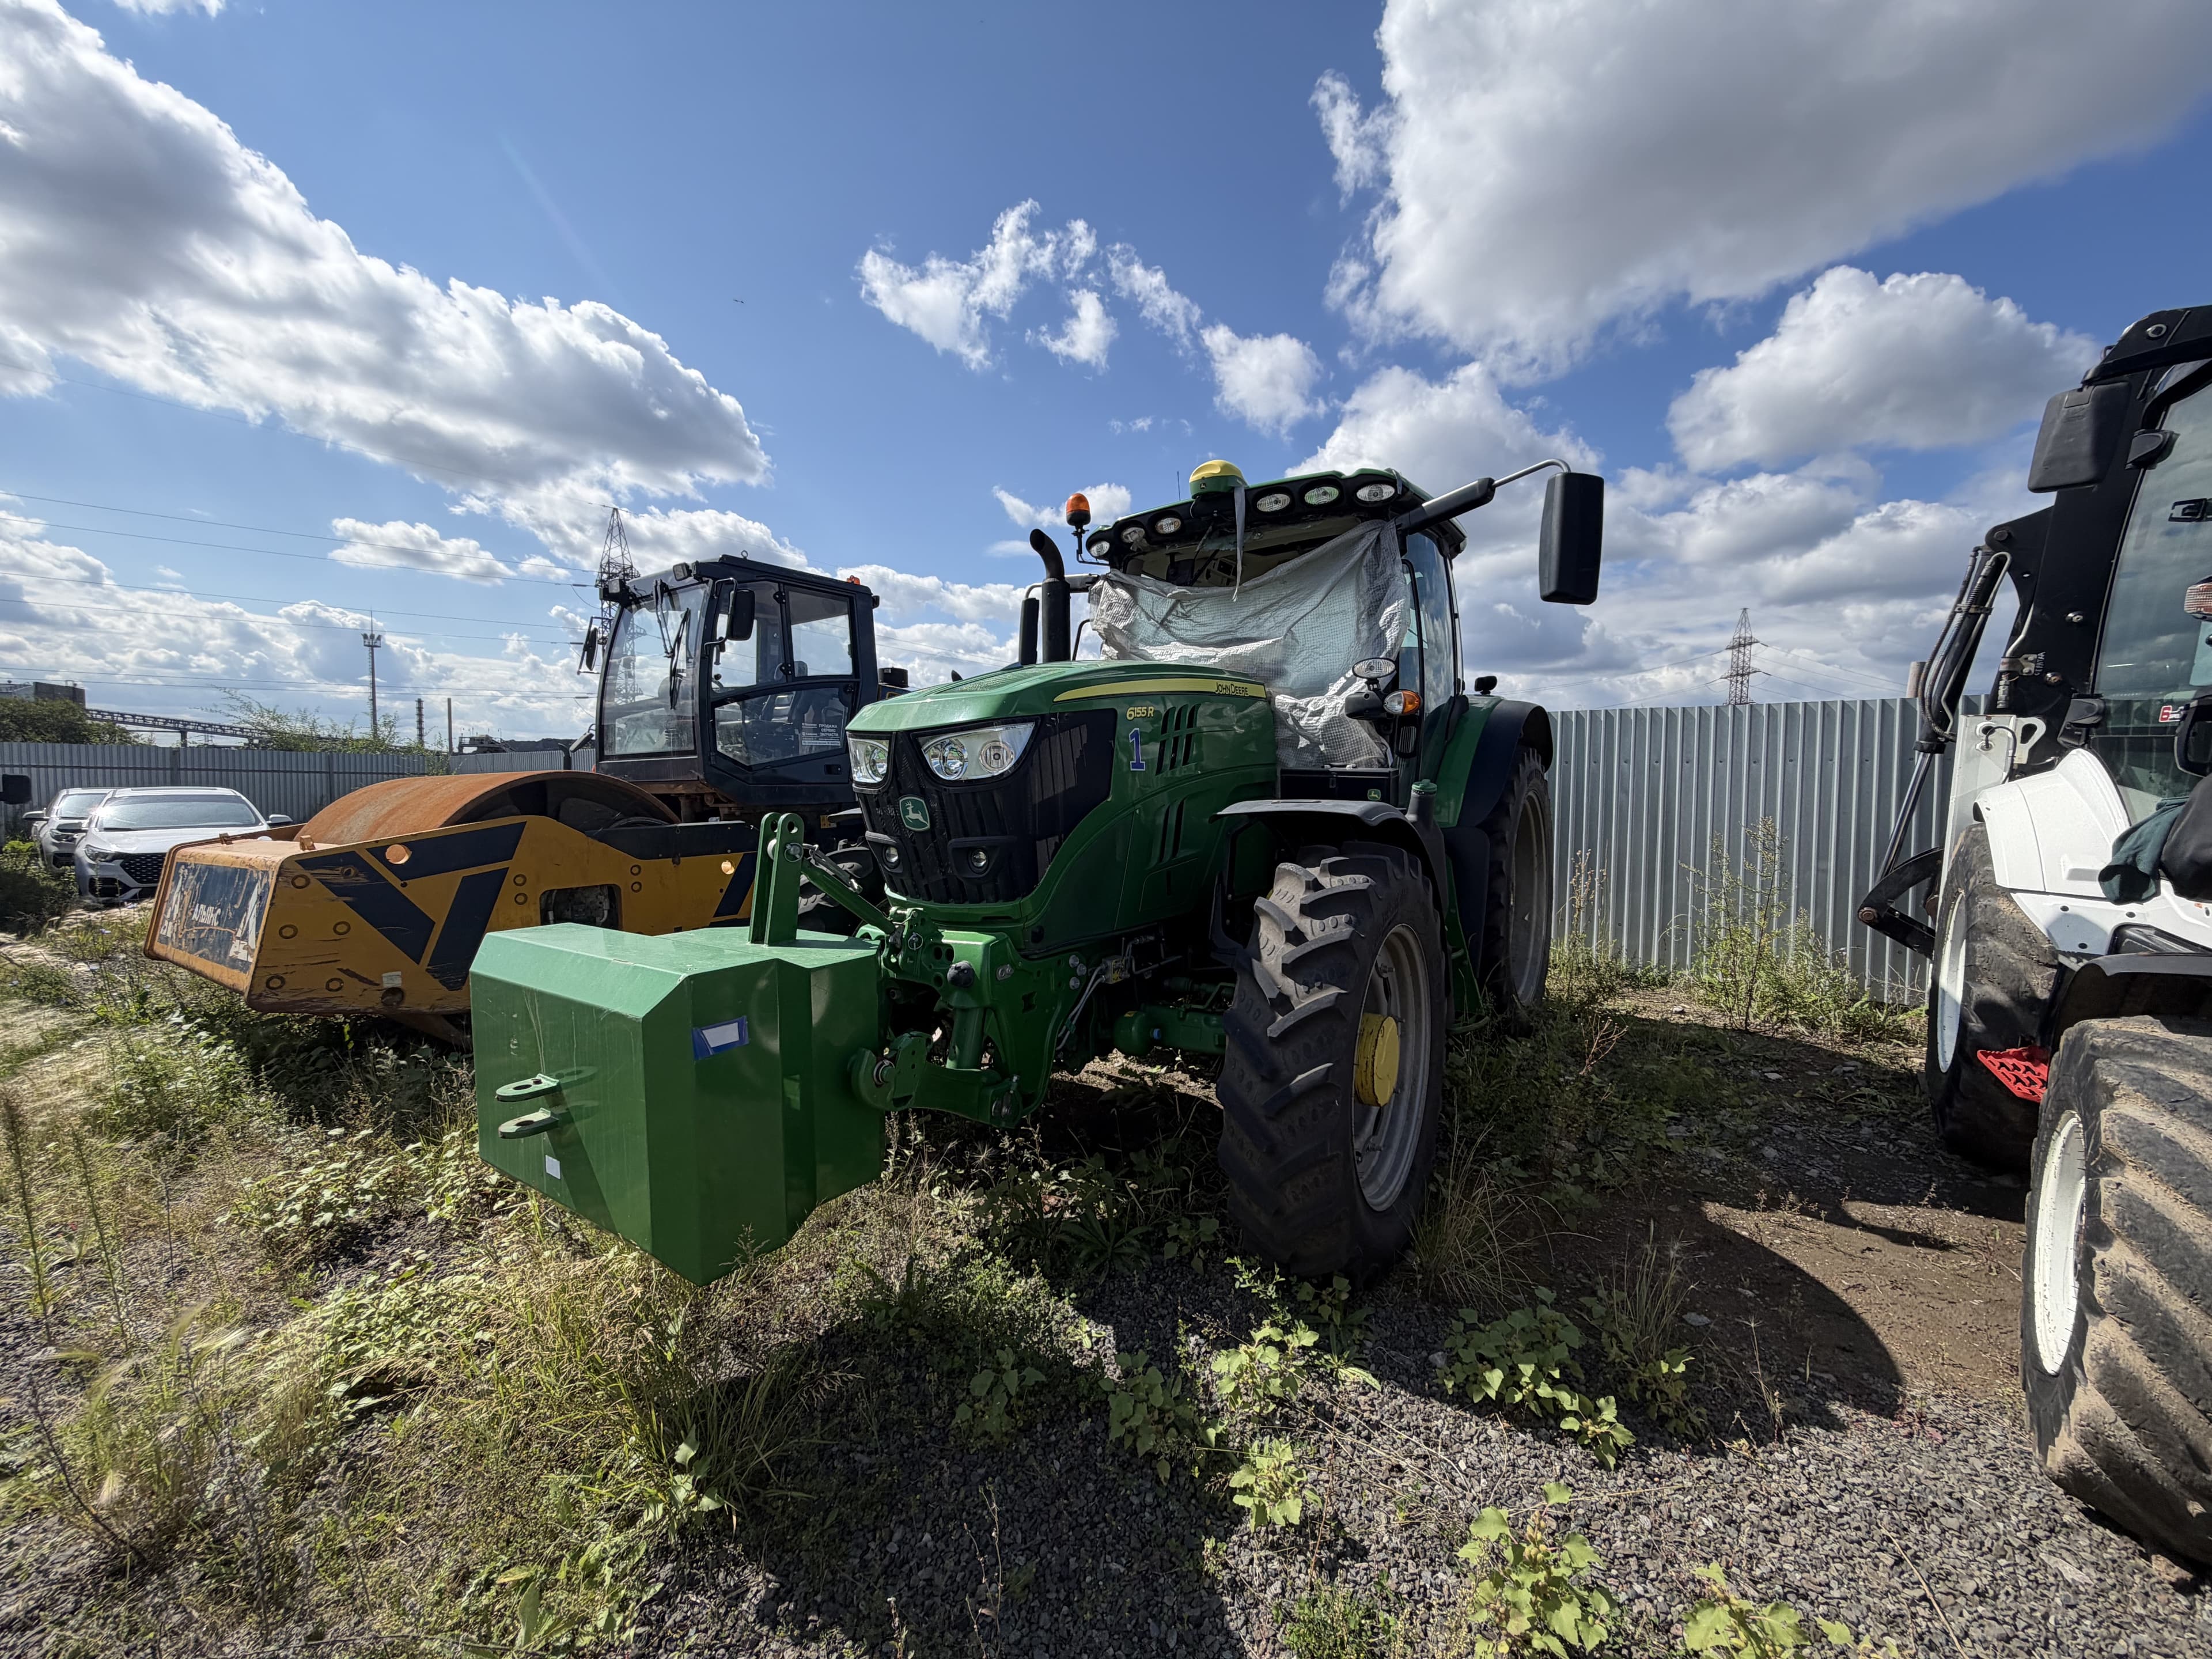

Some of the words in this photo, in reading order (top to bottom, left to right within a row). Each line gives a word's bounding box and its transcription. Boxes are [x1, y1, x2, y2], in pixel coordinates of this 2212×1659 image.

[1215, 681, 1230, 694] JOHN
[1230, 683, 1249, 696] DEERE
[1126, 706, 1147, 720] 6155
[1129, 728, 1145, 771] 1
